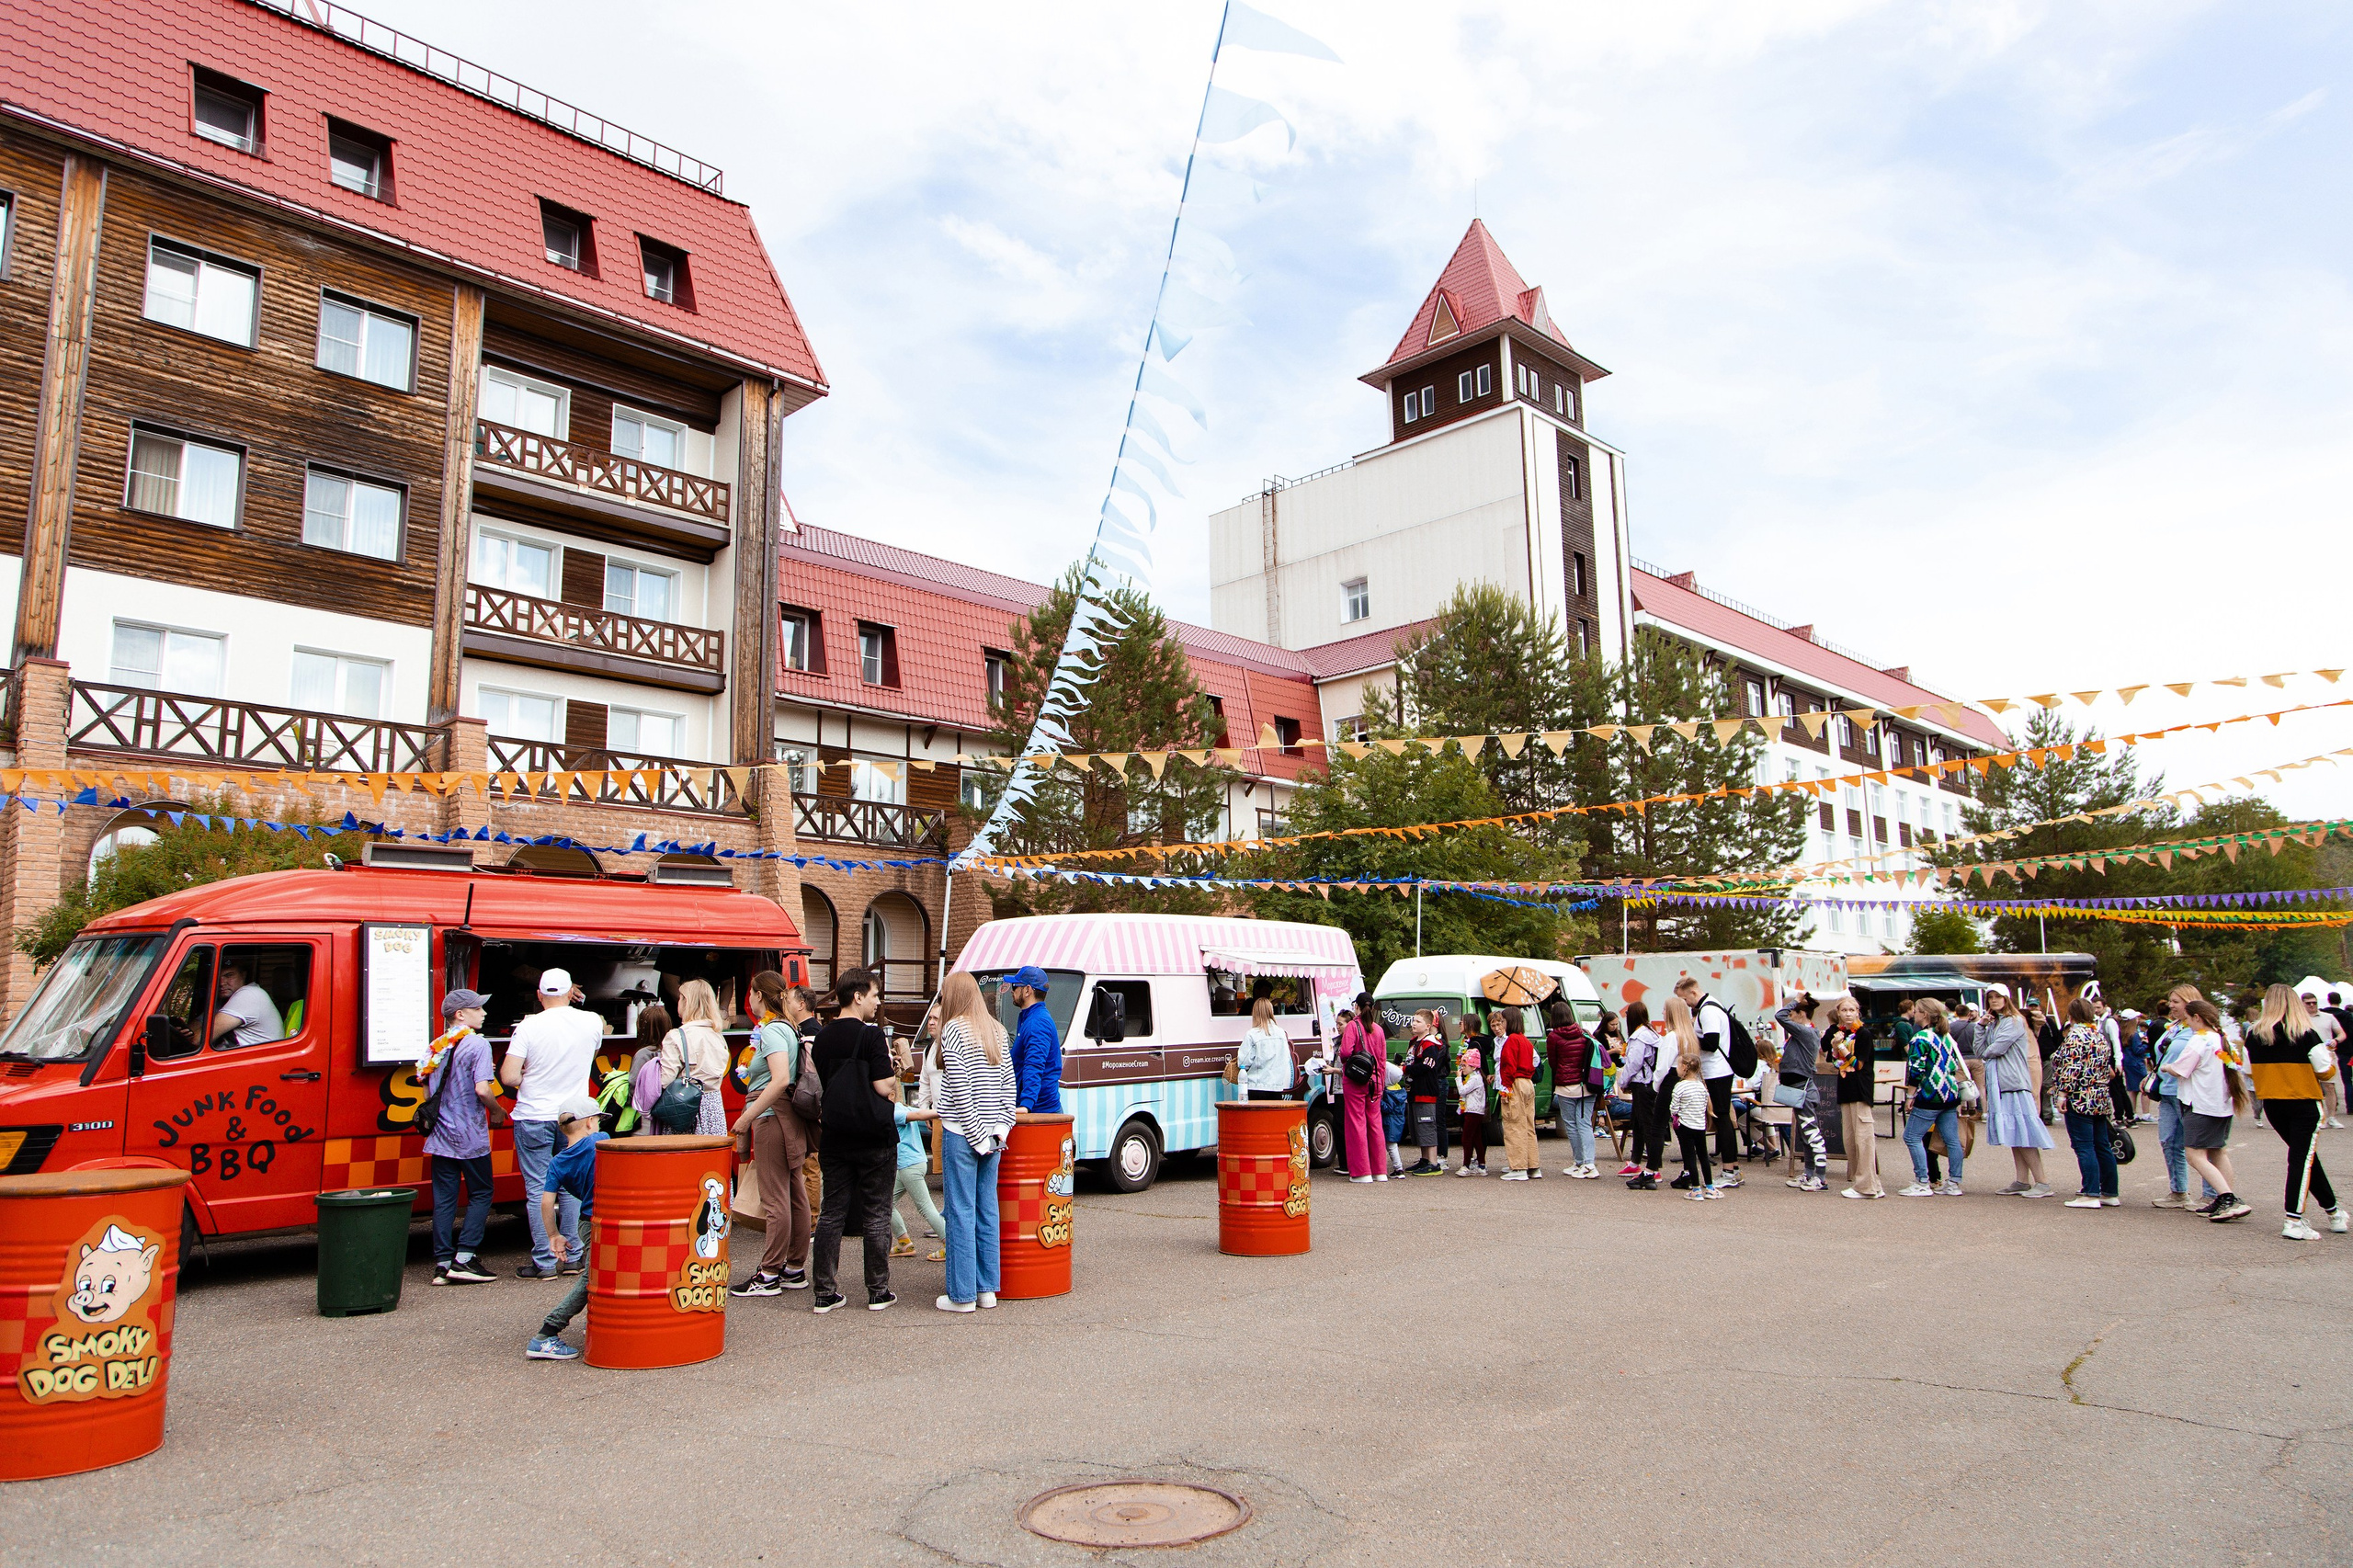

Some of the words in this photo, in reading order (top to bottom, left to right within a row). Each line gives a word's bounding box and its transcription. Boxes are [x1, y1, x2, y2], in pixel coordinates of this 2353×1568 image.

[374, 928, 422, 941] SMOKY
[384, 941, 413, 953] DOG
[1381, 1008, 1415, 1028] JOYF
[1102, 1060, 1149, 1070] #МороженоеCream
[1190, 1055, 1225, 1064] cream.ice.cream
[226, 1116, 246, 1142] &
[190, 1140, 276, 1181] BBQ
[1290, 1181, 1311, 1199] SMO
[1048, 1199, 1074, 1222] SMO
[1286, 1199, 1306, 1215] DOG
[1040, 1222, 1068, 1244] DOG
[675, 1286, 713, 1309] DOG
[44, 1324, 152, 1364] SMOKY
[23, 1363, 98, 1399] DOG
[104, 1356, 158, 1391] DELI
